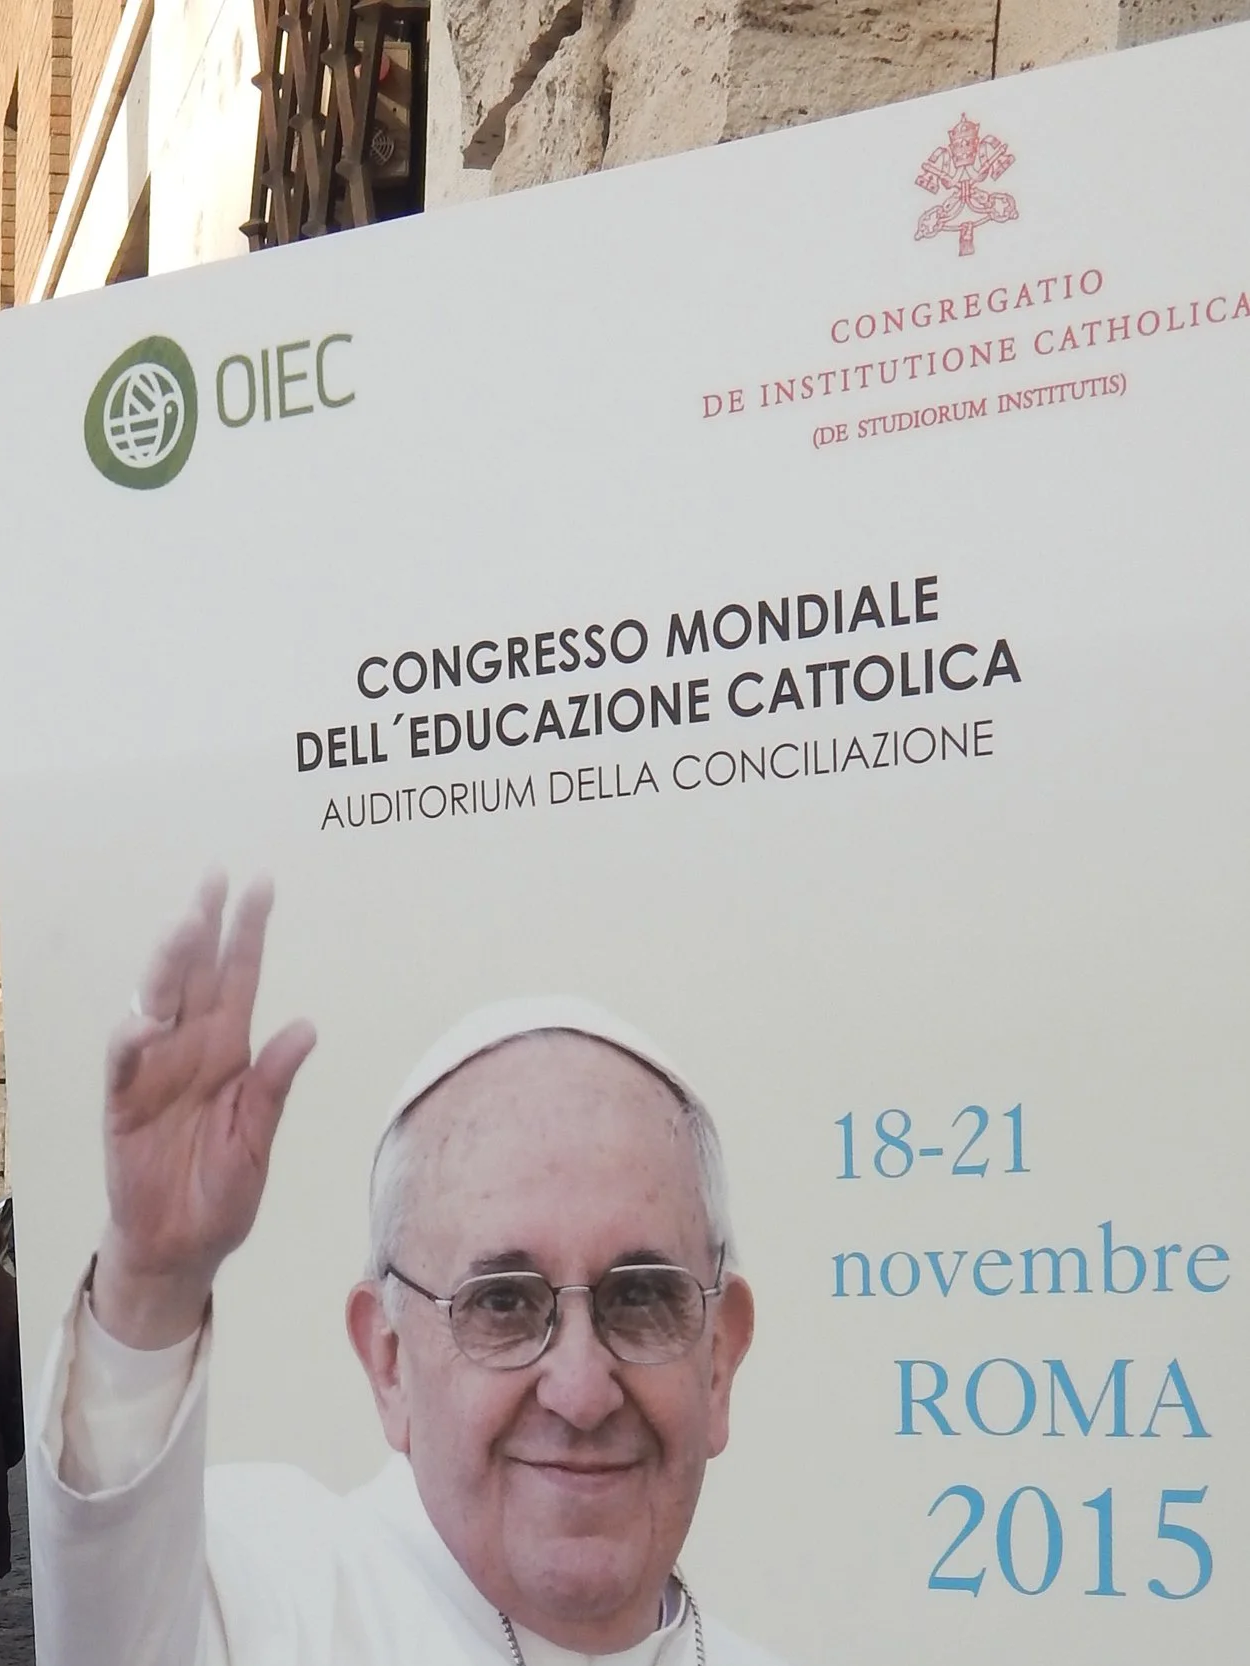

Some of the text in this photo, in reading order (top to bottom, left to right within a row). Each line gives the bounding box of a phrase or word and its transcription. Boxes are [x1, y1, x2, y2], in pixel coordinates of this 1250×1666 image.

[831, 268, 1105, 345] CONGREGATIO
[216, 333, 356, 428] OIEC
[702, 292, 1250, 419] DE INSTITUTIONE CATHOLICA
[812, 373, 1128, 450] (DE STUDIORUM INSTITUTIS)
[356, 575, 940, 699] CONGRESSO MONDIALE
[727, 638, 1022, 718] CATTOLICA
[320, 720, 994, 830] AUDITORIUM DELLA CONCILIAZIONE
[834, 1102, 1031, 1180] 18-21
[831, 1220, 1231, 1298] novembre
[893, 1358, 1213, 1438] ROMA
[927, 1484, 1213, 1600] 2015
